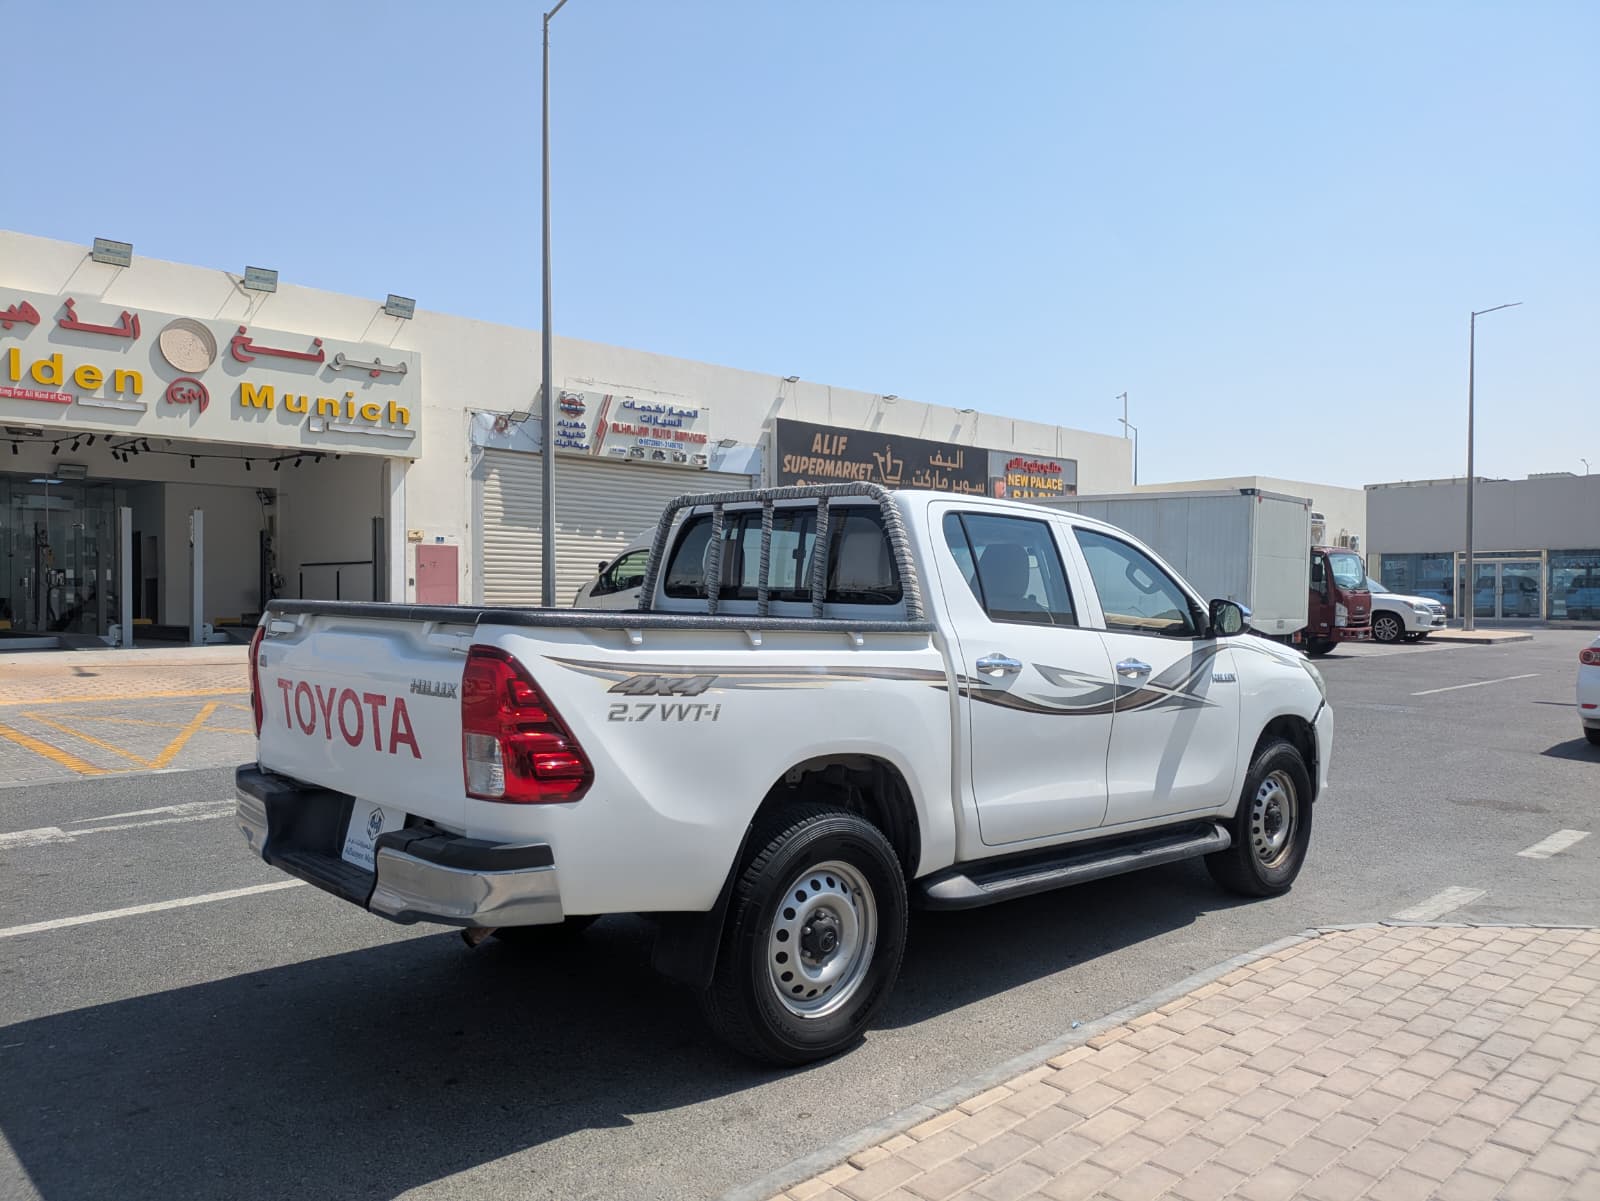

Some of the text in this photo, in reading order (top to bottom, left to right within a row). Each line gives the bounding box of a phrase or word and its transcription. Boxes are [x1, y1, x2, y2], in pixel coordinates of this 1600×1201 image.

[9, 347, 144, 395] lden
[14, 388, 24, 397] For
[25, 389, 34, 398] All
[58, 394, 72, 402] Cars
[240, 382, 410, 425] Munich
[640, 414, 682, 427] السيارات
[653, 427, 672, 440] AUTO
[811, 432, 848, 456] ALIF
[782, 454, 874, 481] SUPERMARKET
[912, 468, 949, 491] ماركت
[1007, 473, 1064, 491] NEW PALACE
[410, 678, 459, 699] HILUX
[277, 678, 422, 759] TOYOTA
[607, 703, 657, 722] 2.7
